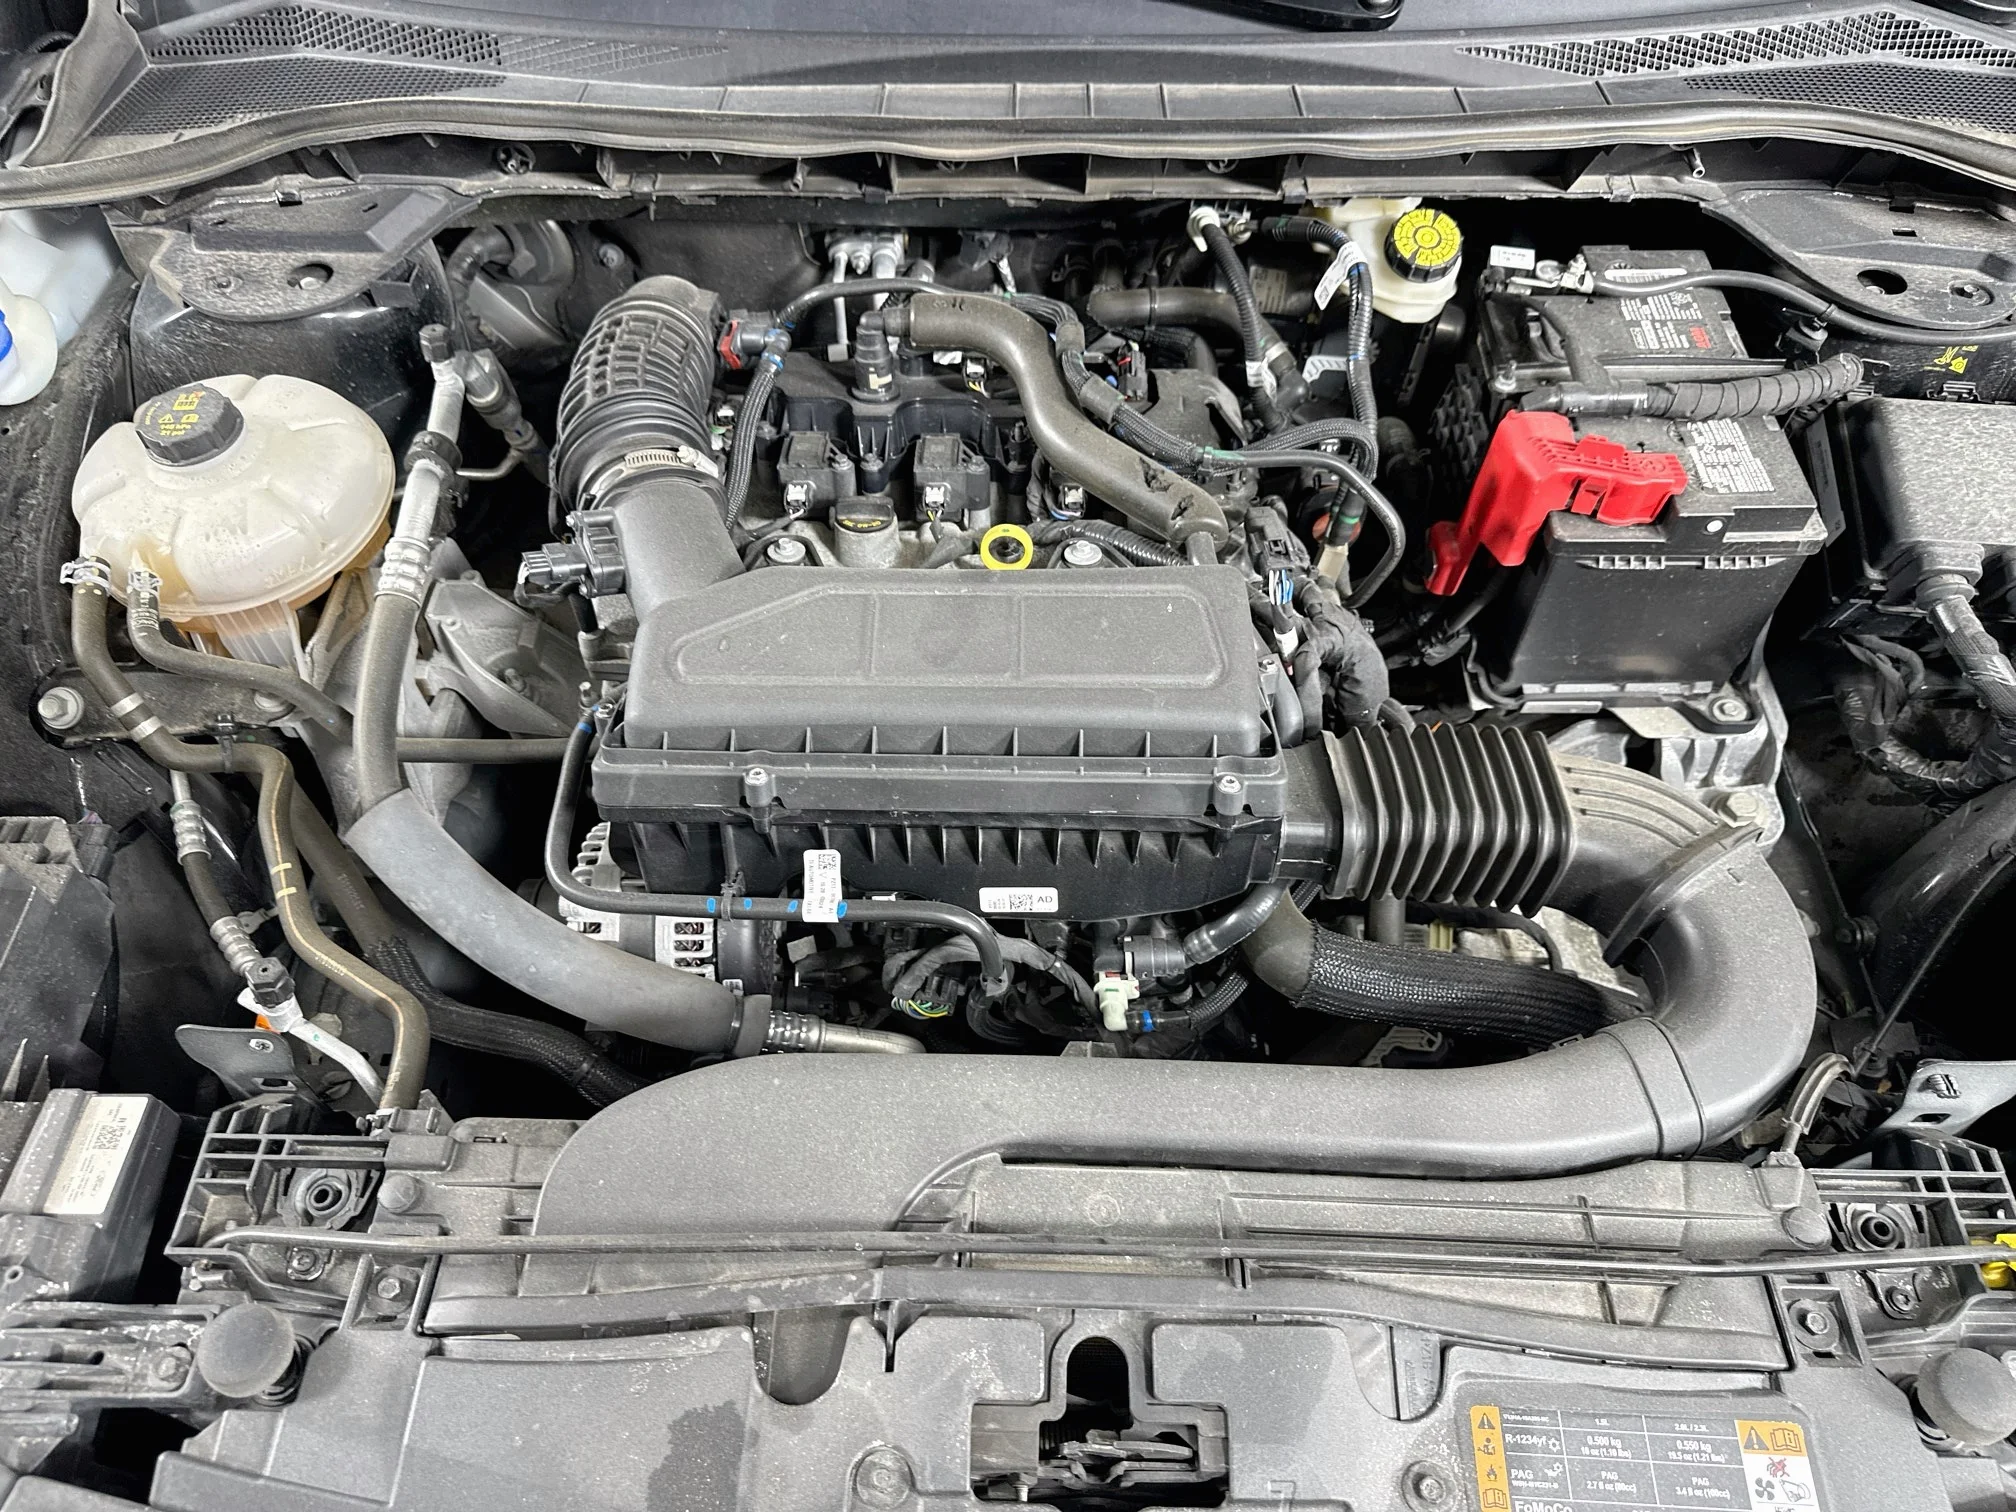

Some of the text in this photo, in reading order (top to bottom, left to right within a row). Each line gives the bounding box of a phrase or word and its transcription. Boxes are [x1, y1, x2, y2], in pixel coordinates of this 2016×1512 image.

[1505, 1433, 1546, 1447] R-1234yf
[1587, 1435, 1622, 1448] 0.500 kg
[1676, 1440, 1712, 1453] 0.550 kg
[1693, 1452, 1710, 1462] (1.21
[1511, 1469, 1534, 1479] PAG
[1601, 1471, 1618, 1480] PAG
[1691, 1477, 1709, 1486] PAG
[1605, 1483, 1614, 1491] oz
[1694, 1489, 1703, 1497] oz
[1515, 1501, 1573, 1512] FoMoCo
